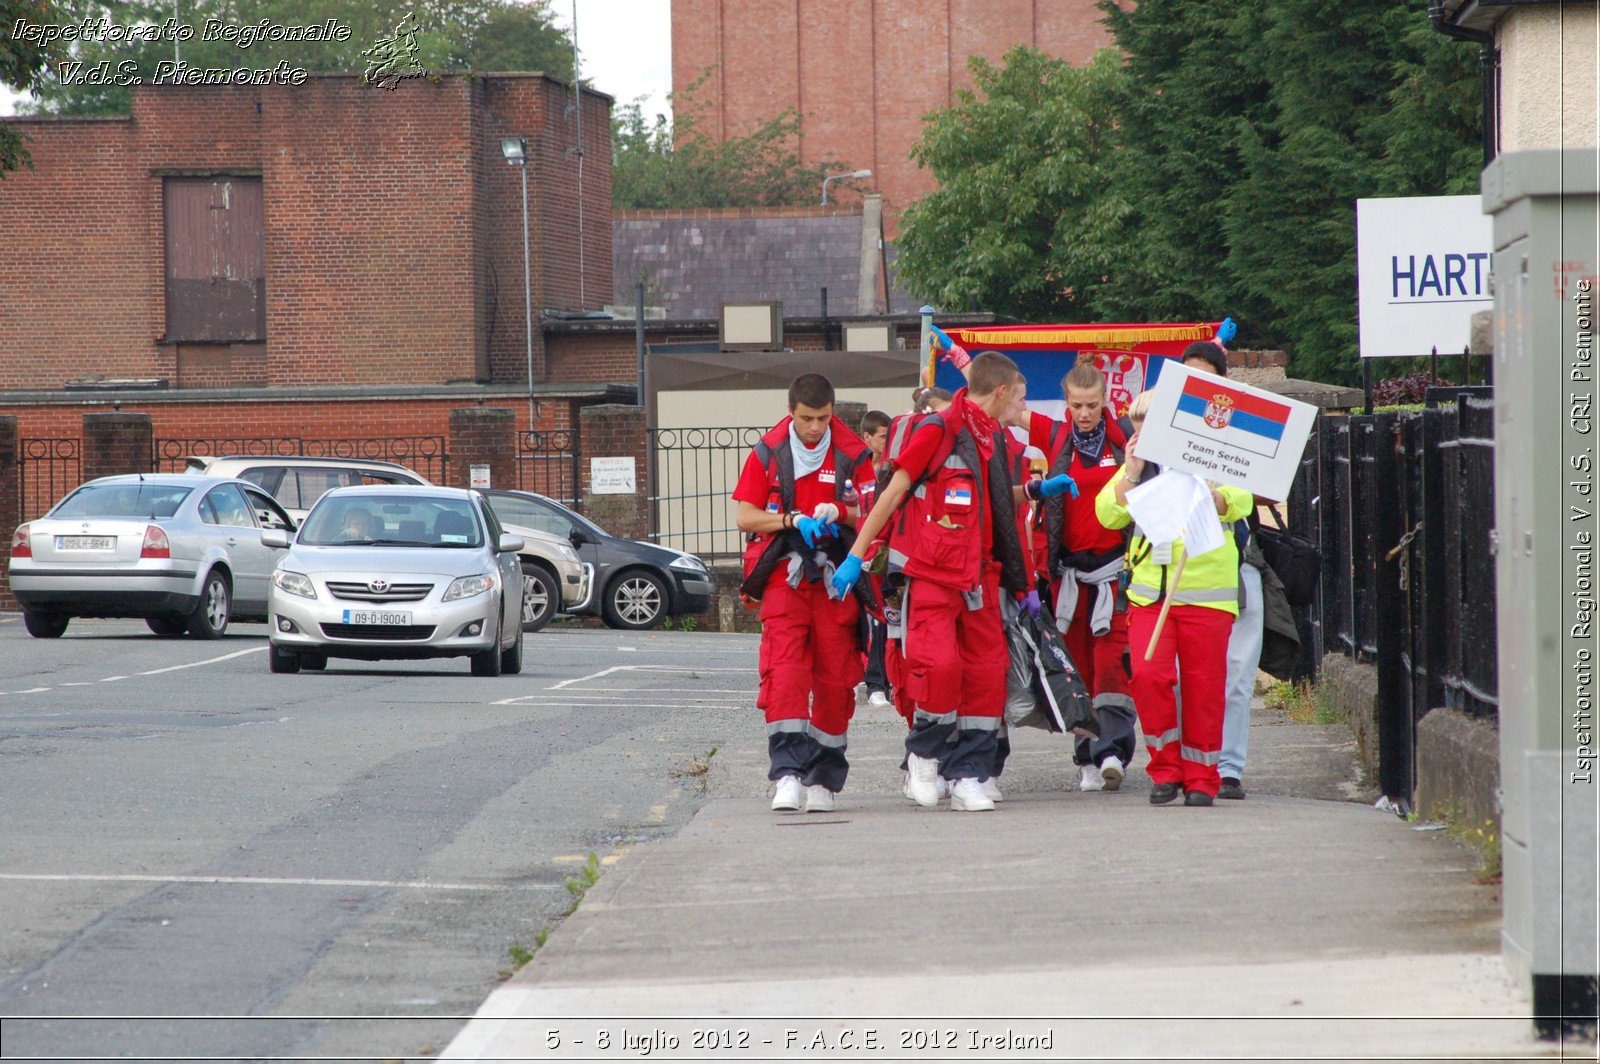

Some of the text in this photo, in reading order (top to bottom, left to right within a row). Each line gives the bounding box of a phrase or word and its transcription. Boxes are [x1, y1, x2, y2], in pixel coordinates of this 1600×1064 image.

[1182, 452, 1218, 469] Србија
[1187, 440, 1250, 467] Team Serbia
